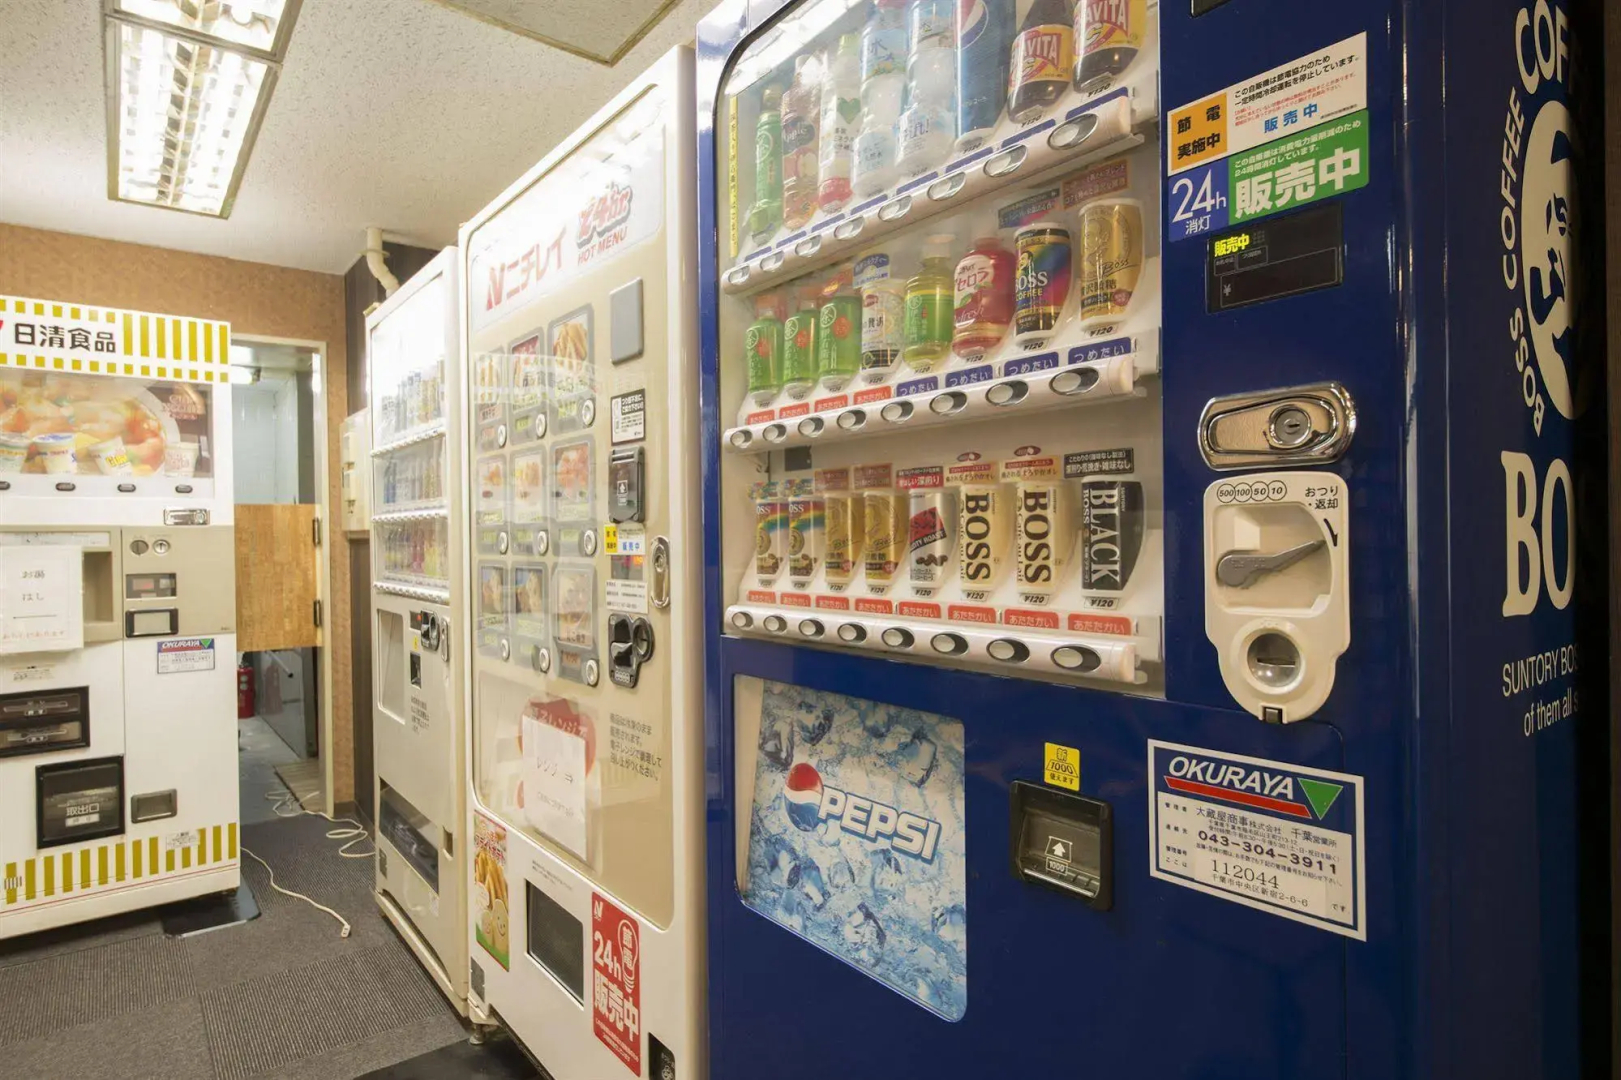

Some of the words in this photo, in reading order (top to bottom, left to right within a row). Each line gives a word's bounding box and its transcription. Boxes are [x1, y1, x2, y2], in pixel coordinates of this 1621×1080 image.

[1264, 103, 1318, 133] 販売中
[1177, 132, 1221, 160] 実施中
[1235, 146, 1360, 219] 販売中
[1501, 87, 1524, 290] COFFEE
[1172, 169, 1226, 223] 24h
[1185, 214, 1211, 235] 消灯
[578, 244, 597, 266] HOT
[597, 226, 628, 254] MENU
[1214, 233, 1250, 257] 販売中
[14, 322, 116, 353] 日清食品
[1090, 327, 1113, 337] ¥120
[1023, 342, 1044, 351] ¥120
[1074, 346, 1125, 363] つめたい
[1008, 360, 1053, 374] つめたい
[1509, 307, 1545, 437] BOSS
[949, 372, 989, 387] つめたい
[900, 383, 935, 396] つめたい
[1219, 488, 1234, 498] 500
[1236, 488, 1250, 498] 100
[1253, 487, 1266, 496] 50
[1271, 486, 1283, 496] 10
[1305, 486, 1339, 498] おつり
[965, 493, 991, 580] BOSS
[1024, 490, 1051, 583] BOSS
[1090, 488, 1120, 583] BLACK
[870, 586, 885, 594] ¥120
[915, 589, 932, 597] ¥120
[966, 592, 984, 600] ¥120
[857, 602, 890, 613] あたたかい
[1024, 595, 1045, 604] ¥120
[1090, 598, 1114, 607] ¥120
[902, 605, 938, 618] あたたかい
[952, 610, 991, 622] あたたかい
[1009, 615, 1053, 628] あたたかい
[1073, 620, 1126, 633] あたたかい
[1502, 648, 1560, 697] SUNTORY
[1524, 699, 1535, 737] of
[1537, 696, 1560, 731] them
[1562, 687, 1572, 719] all
[1050, 762, 1073, 774] 1000
[1050, 772, 1074, 785] 使えます
[1168, 756, 1294, 800] OKURAYA
[817, 784, 941, 865] PEPSI
[1196, 806, 1282, 835] 大蔵屋商事株式会社
[1291, 828, 1337, 848] 千葉営業所
[1198, 830, 1337, 875] 043-304-3911
[1049, 861, 1066, 872] 1000
[1211, 859, 1279, 889] 112044
[594, 930, 622, 982] 24h
[594, 968, 639, 1042] 販売中
